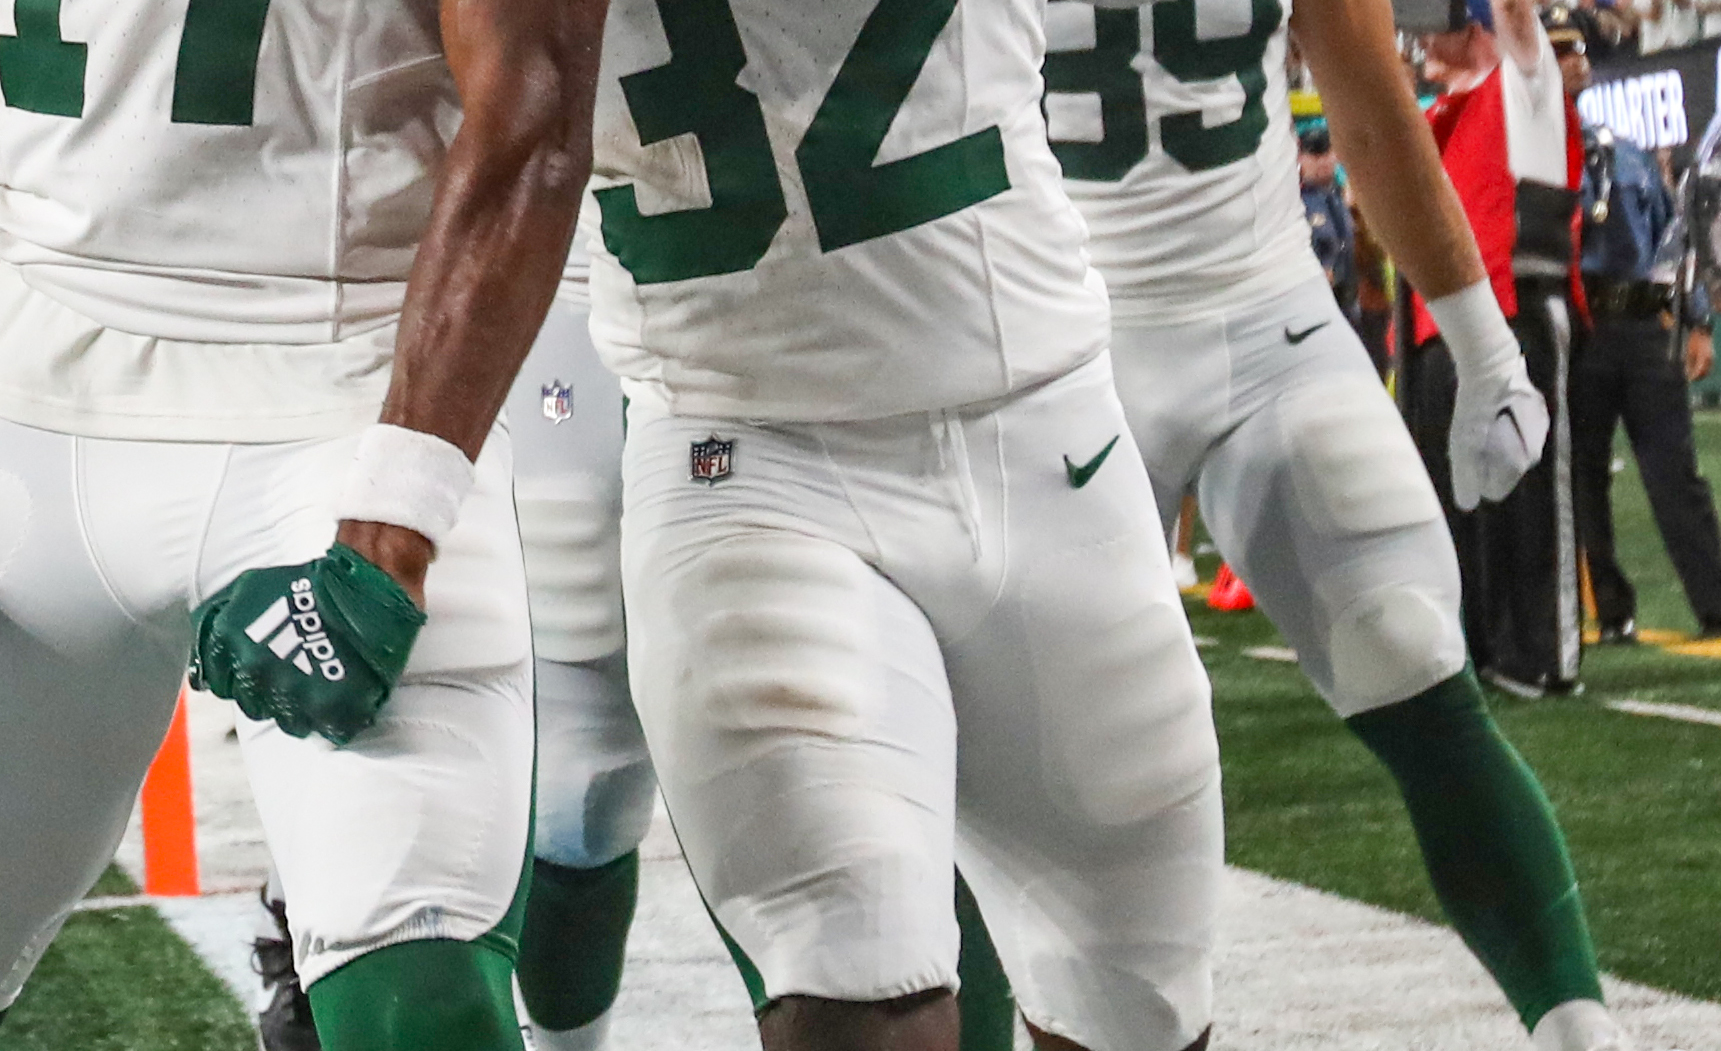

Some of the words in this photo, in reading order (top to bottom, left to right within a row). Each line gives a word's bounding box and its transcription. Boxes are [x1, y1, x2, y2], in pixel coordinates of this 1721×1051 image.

[1576, 68, 1689, 150] QUARTER
[696, 456, 728, 477] NFL
[290, 577, 347, 682] adidas
